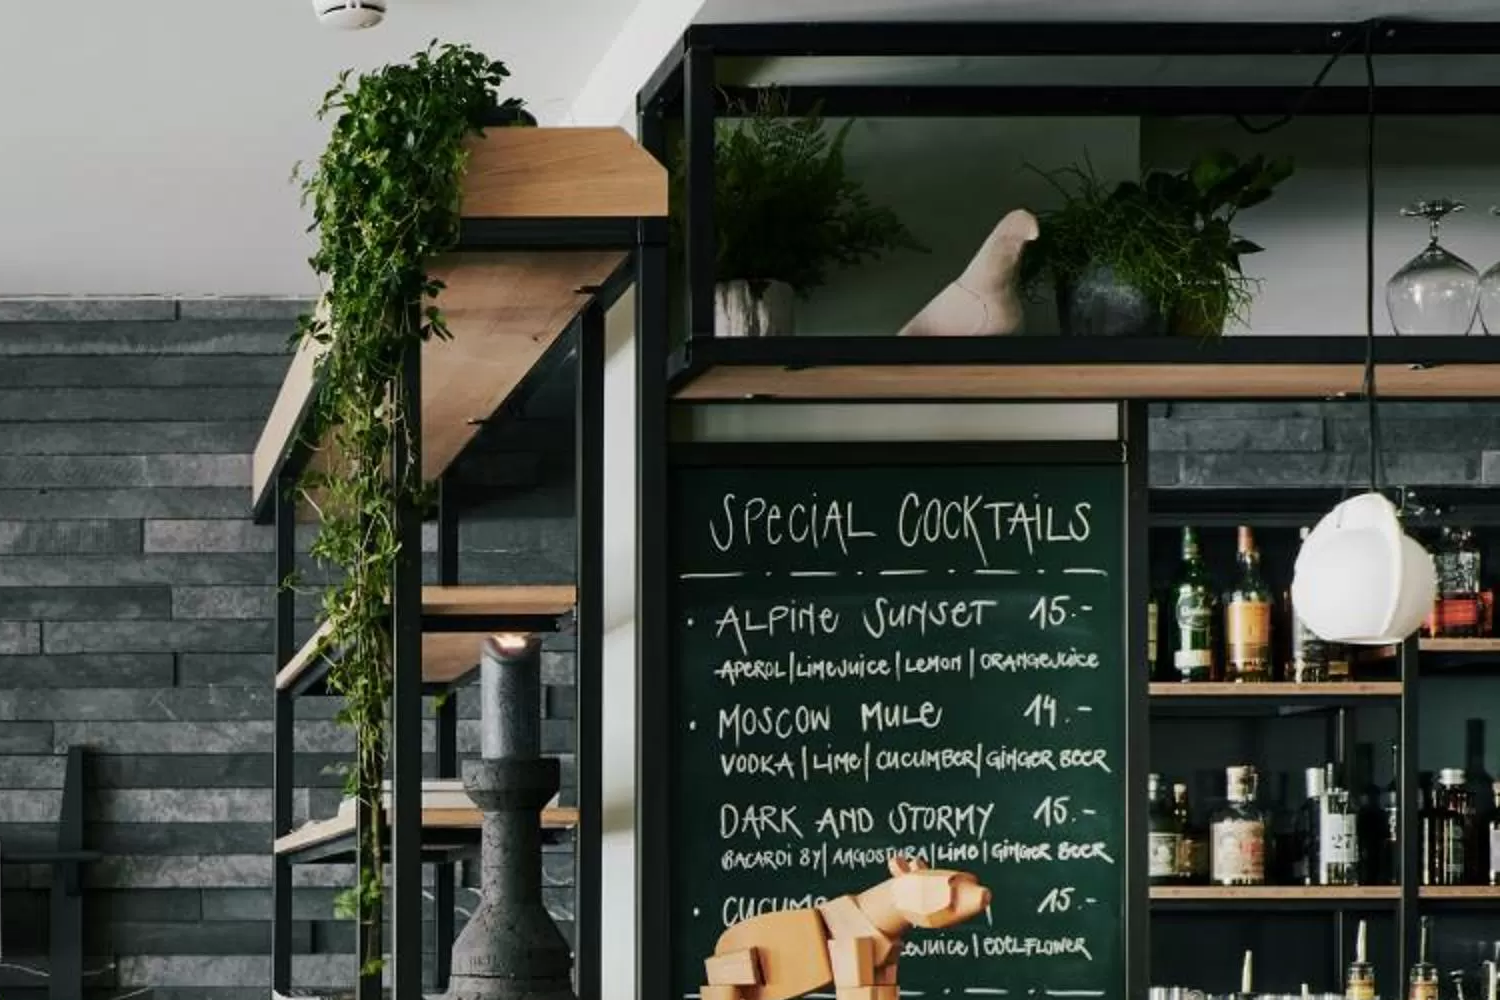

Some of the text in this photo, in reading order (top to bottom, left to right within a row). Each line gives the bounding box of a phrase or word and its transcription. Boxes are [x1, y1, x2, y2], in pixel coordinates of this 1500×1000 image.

[718, 703, 831, 747] MOSCOW
[720, 752, 795, 779] VODKA
[720, 803, 804, 840] DARK
[815, 807, 874, 839] AND
[889, 802, 995, 840] STORMY
